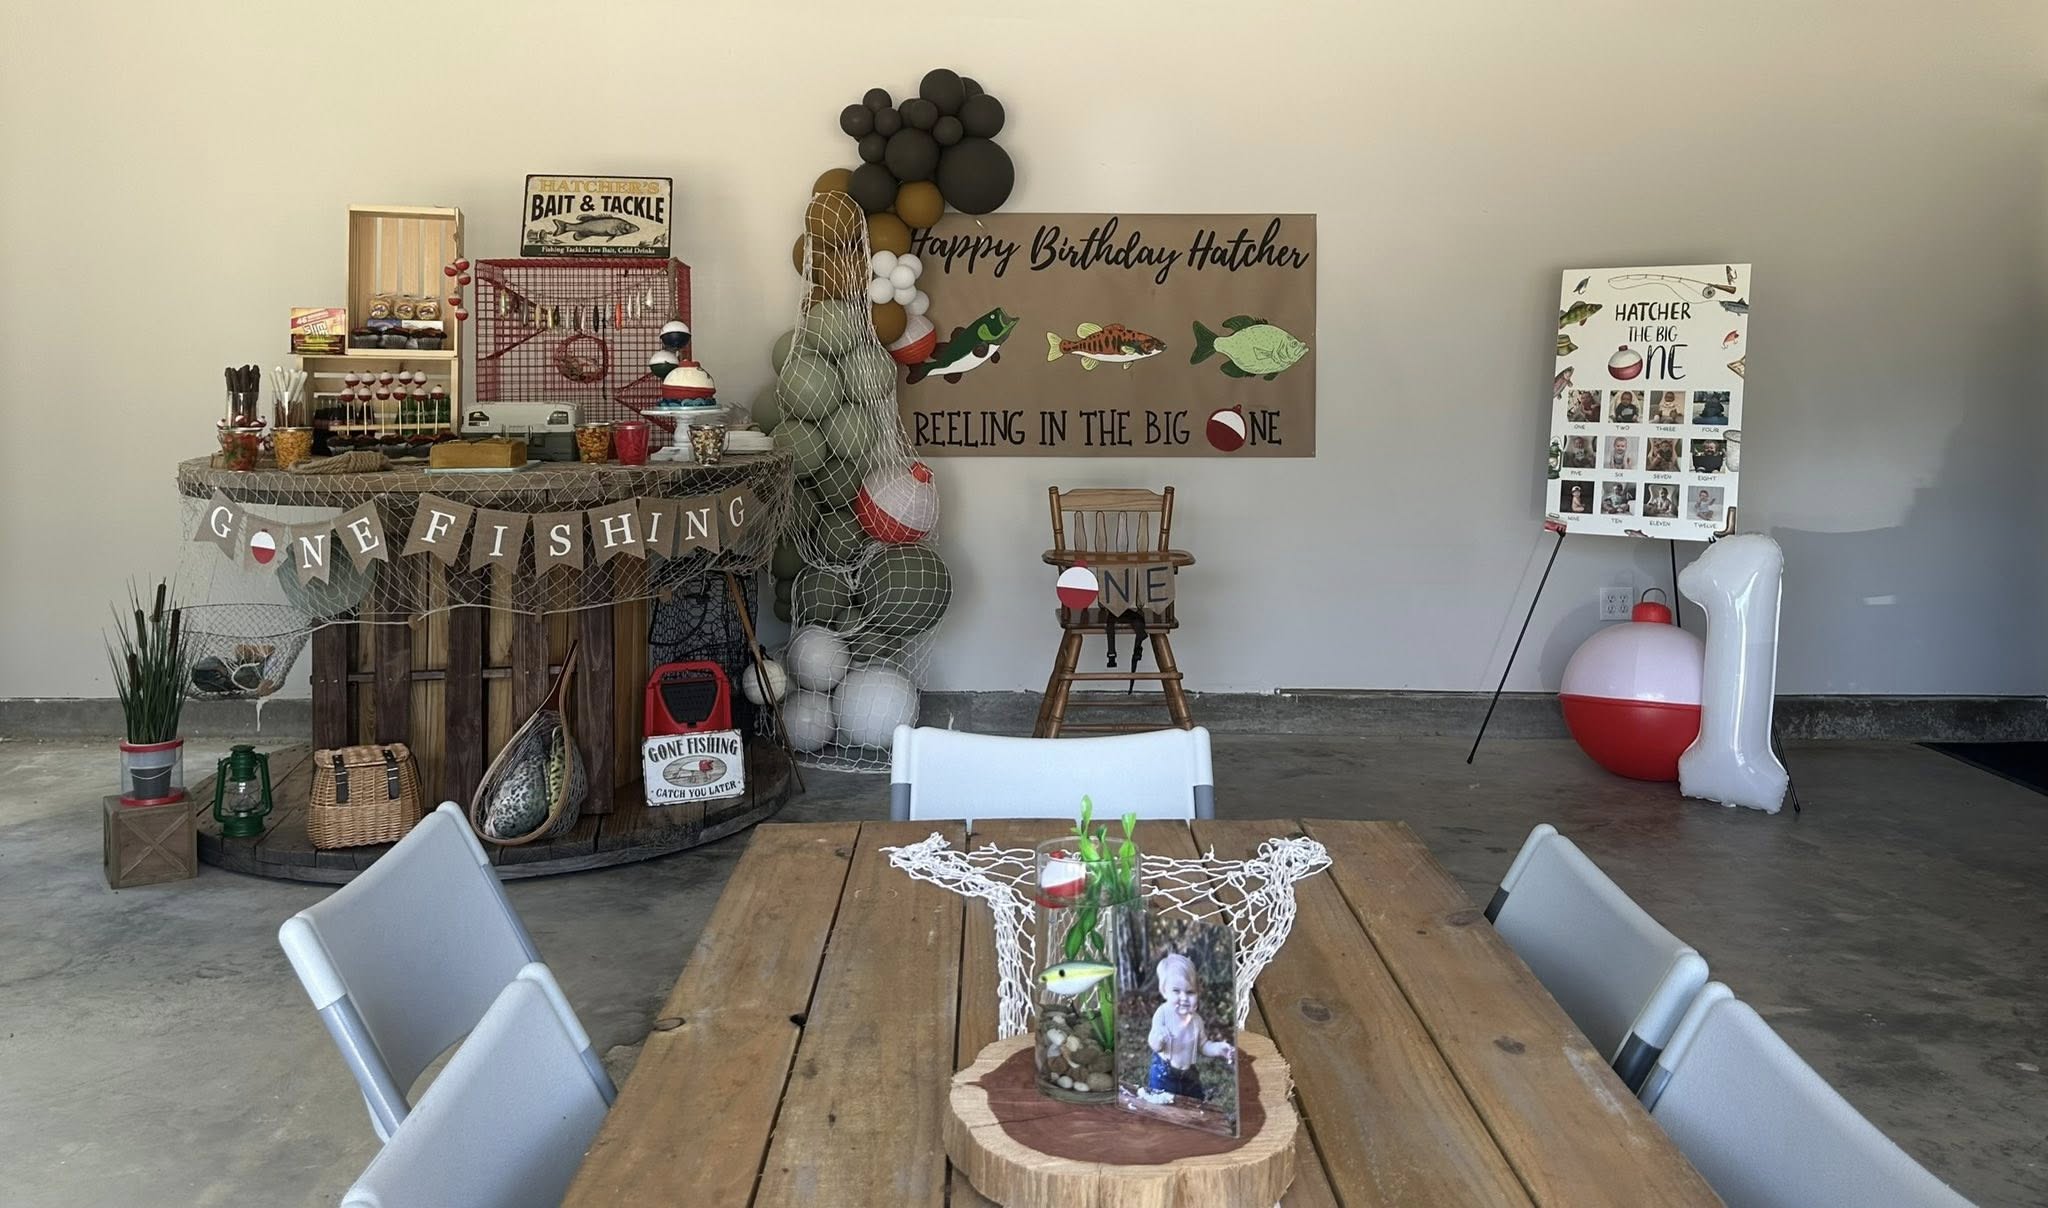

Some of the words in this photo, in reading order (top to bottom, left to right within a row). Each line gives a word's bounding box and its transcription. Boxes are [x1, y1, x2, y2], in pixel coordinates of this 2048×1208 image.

[538, 178, 660, 195] HATCHER'S
[531, 194, 575, 222] BAIT
[579, 194, 595, 212] &
[600, 195, 665, 224] TACKLE
[541, 246, 564, 254] Fishing
[909, 228, 1021, 278] Happy
[1030, 216, 1183, 285] Birthday
[1187, 217, 1310, 273] Hatcher
[1615, 301, 1692, 322] HATCHER
[1628, 325, 1653, 342] THE
[1656, 325, 1679, 342] BIG
[913, 410, 1025, 448] REELING
[1039, 410, 1067, 446] IN
[1079, 409, 1133, 447] THE
[1144, 410, 1191, 446] BIG
[421, 496, 746, 557] FISHING
[648, 738, 684, 763] GONE
[687, 736, 738, 756] FISHING
[656, 788, 686, 799] CATCH
[688, 787, 707, 798] YOU
[709, 780, 737, 795] LATER
